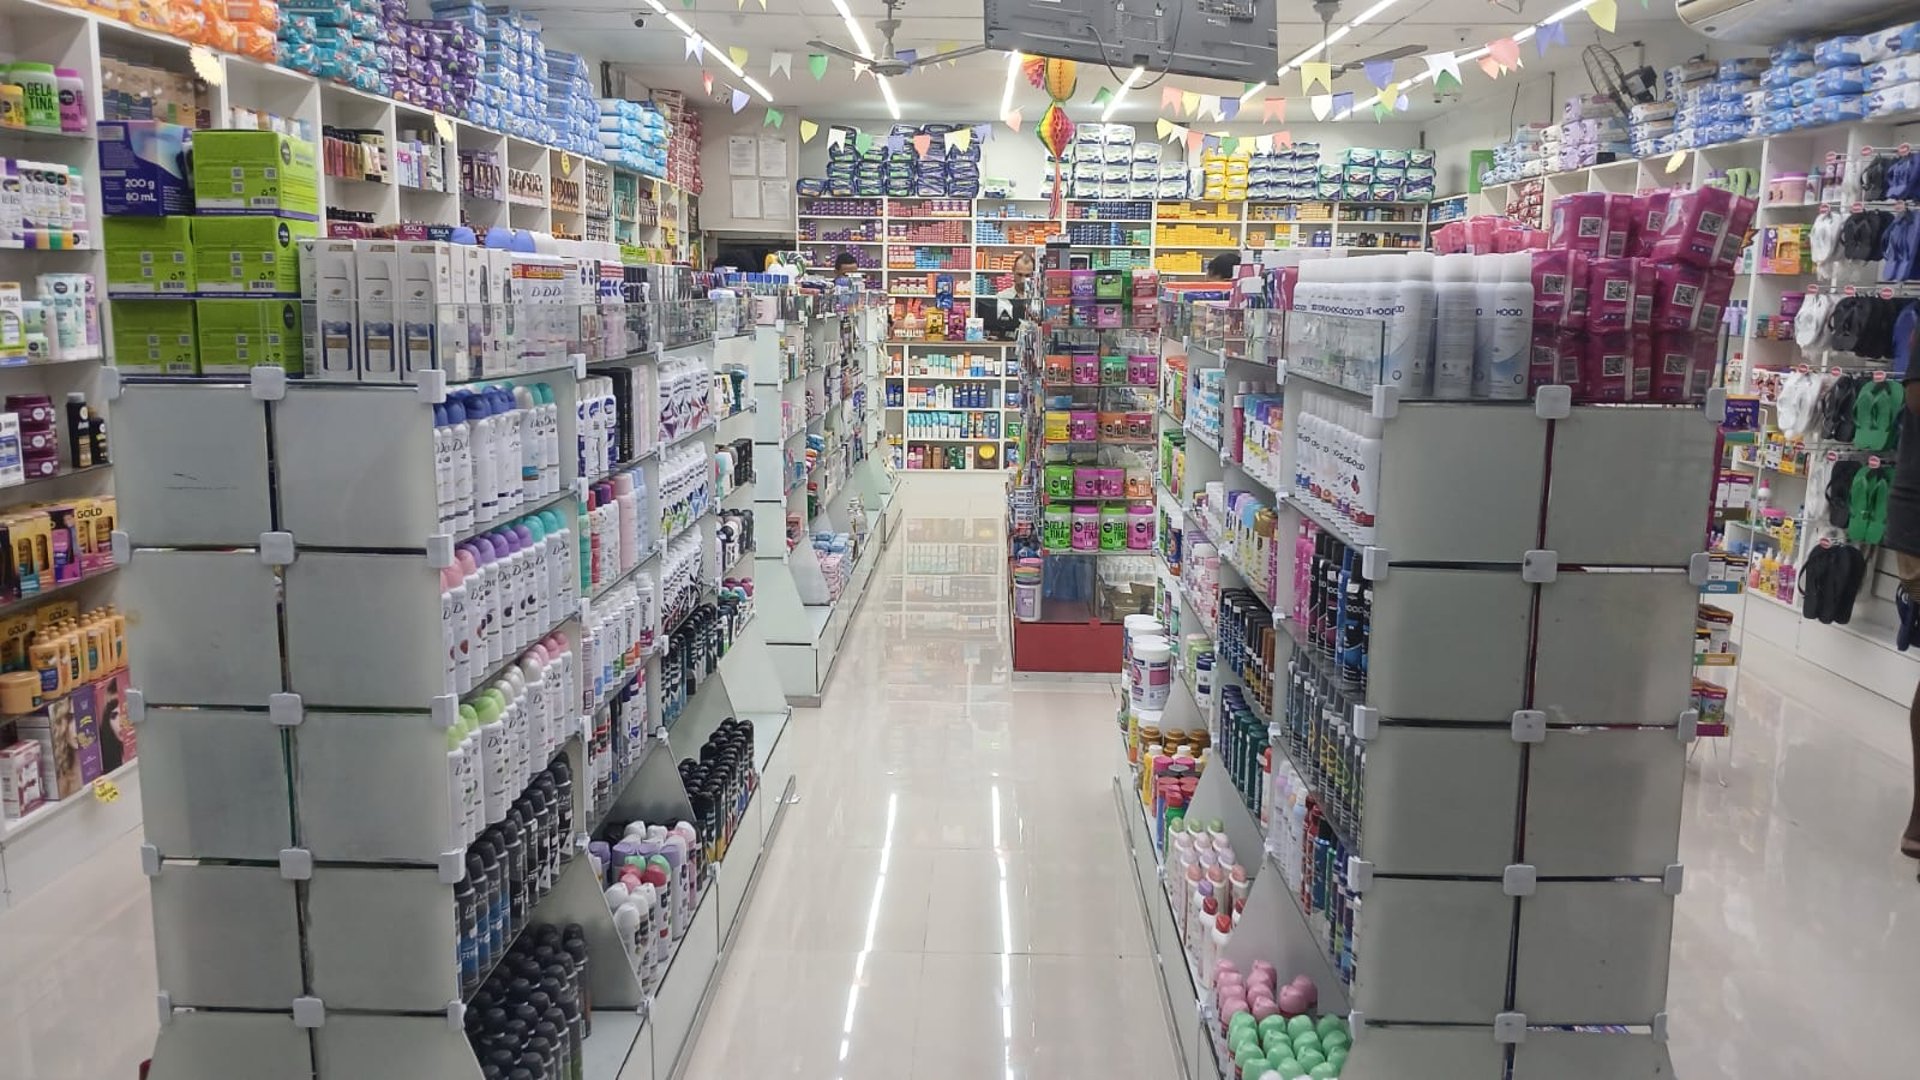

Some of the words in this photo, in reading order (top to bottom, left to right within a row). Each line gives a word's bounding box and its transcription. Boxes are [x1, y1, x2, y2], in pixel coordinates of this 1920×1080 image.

[27, 82, 52, 96] GELA
[29, 96, 54, 110] TINA
[125, 178, 146, 188] 200
[148, 180, 155, 190] g
[77, 508, 102, 519] GOLD
[49, 609, 69, 621] GOLD
[8, 623, 27, 636] GOLD
